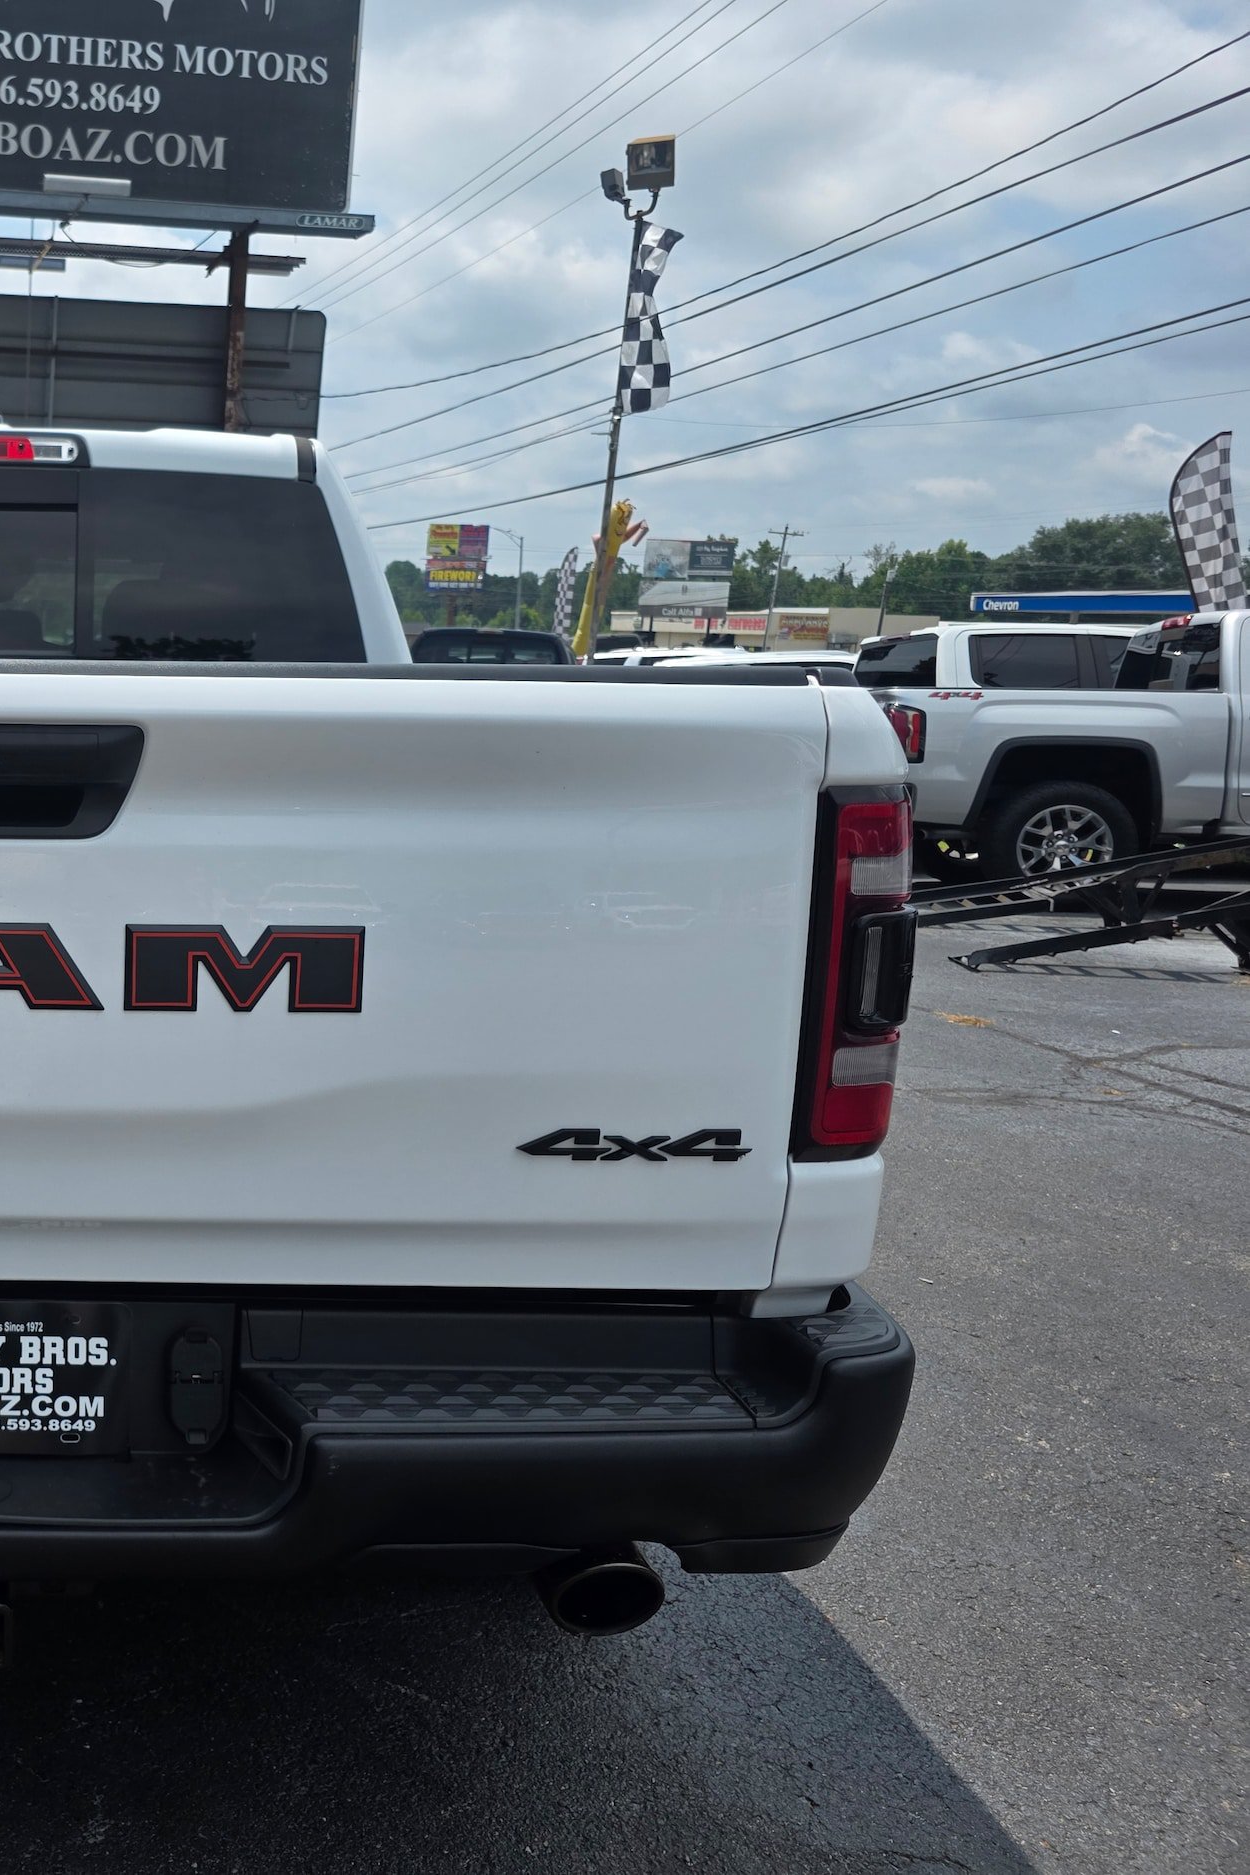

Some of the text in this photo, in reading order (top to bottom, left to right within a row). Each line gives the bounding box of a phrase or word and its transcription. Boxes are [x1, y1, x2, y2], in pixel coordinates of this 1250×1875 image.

[173, 43, 329, 86] MOTORS
[304, 216, 358, 228] LAMAR
[982, 599, 1019, 611] Chevron
[516, 1128, 752, 1161] 4x4
[4, 1322, 25, 1332] Since
[26, 1322, 44, 1332] 1972
[19, 1336, 117, 1366] BROS.
